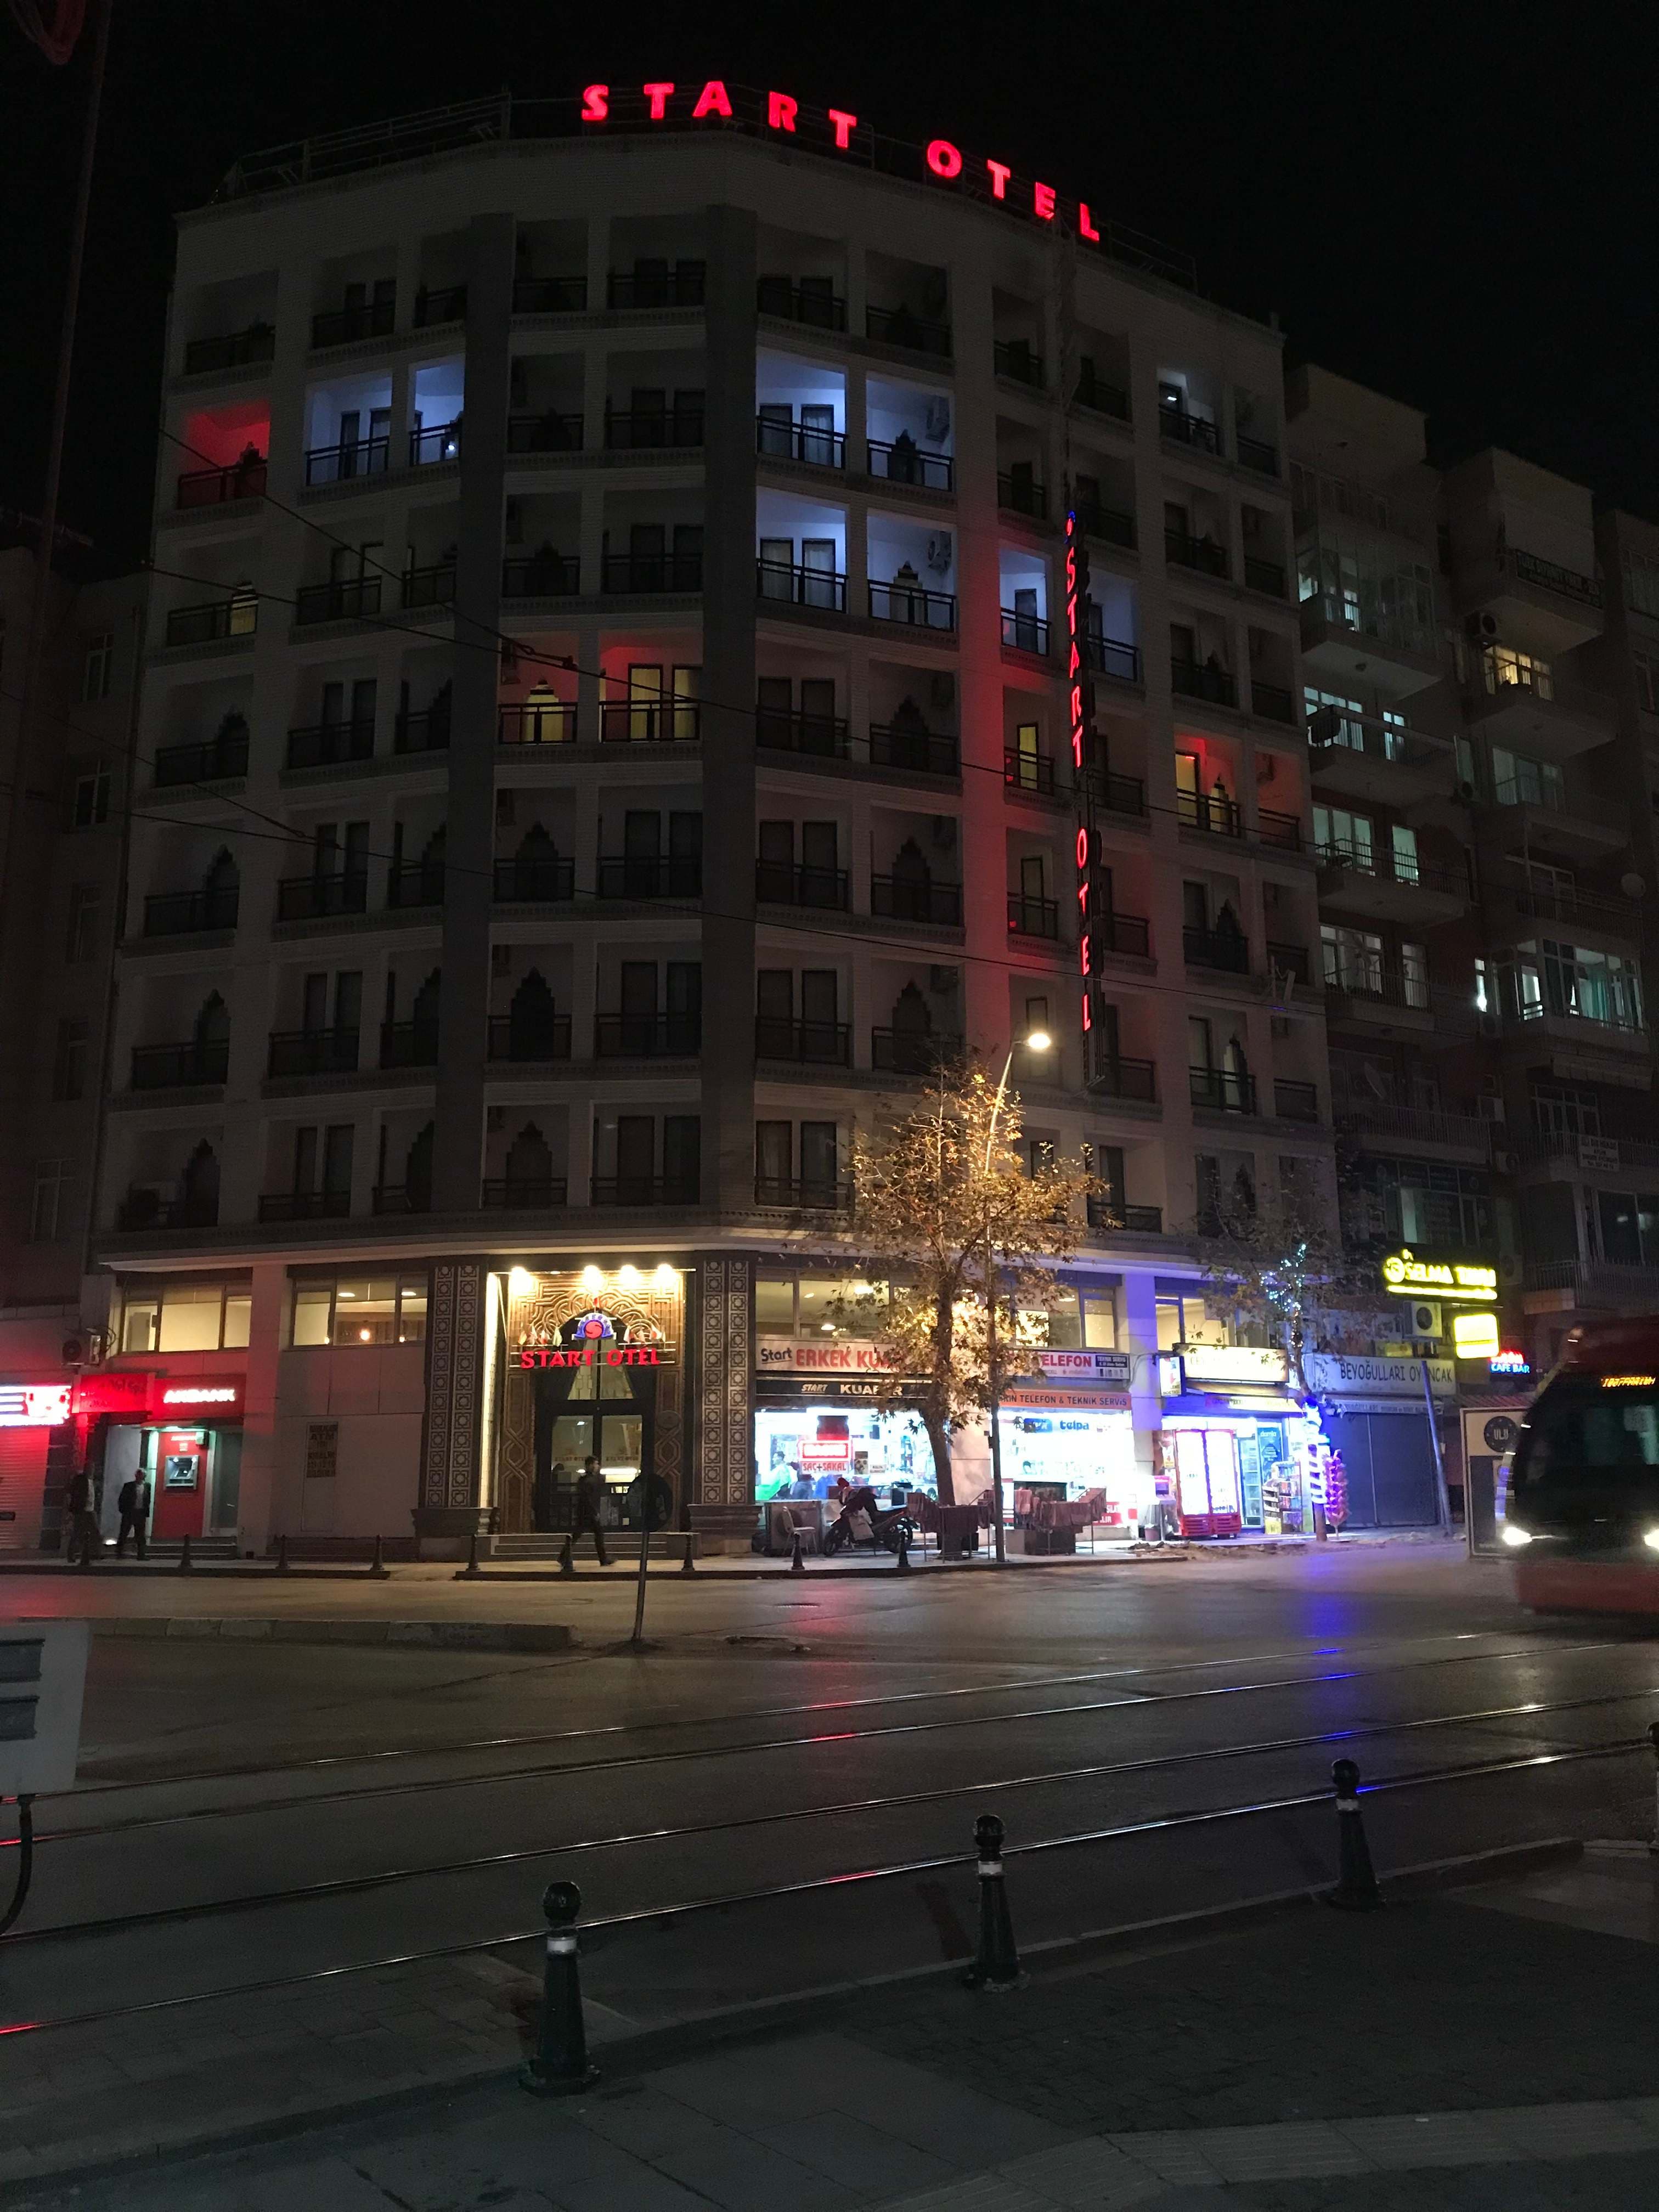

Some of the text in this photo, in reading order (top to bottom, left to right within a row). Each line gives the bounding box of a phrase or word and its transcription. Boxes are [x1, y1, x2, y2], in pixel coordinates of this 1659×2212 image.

[582, 81, 1099, 241] START OTEL
[1066, 546, 1091, 1031] START OTEL
[520, 1347, 661, 1369] START OTEL
[761, 1347, 792, 1362] Start
[796, 1349, 851, 1368] ERKEK
[1040, 1354, 1092, 1367] ELEFON
[1340, 1359, 1453, 1383] BEYOĞULLARI OYNCAK
[1513, 1364, 1530, 1373] BAR
[802, 1384, 903, 1396] START KUAFR
[1020, 1395, 1056, 1404] TELEFON
[1067, 1396, 1097, 1405] TEKNİK
[1099, 1397, 1127, 1406] SERVİS
[1060, 1420, 1090, 1430] telpa
